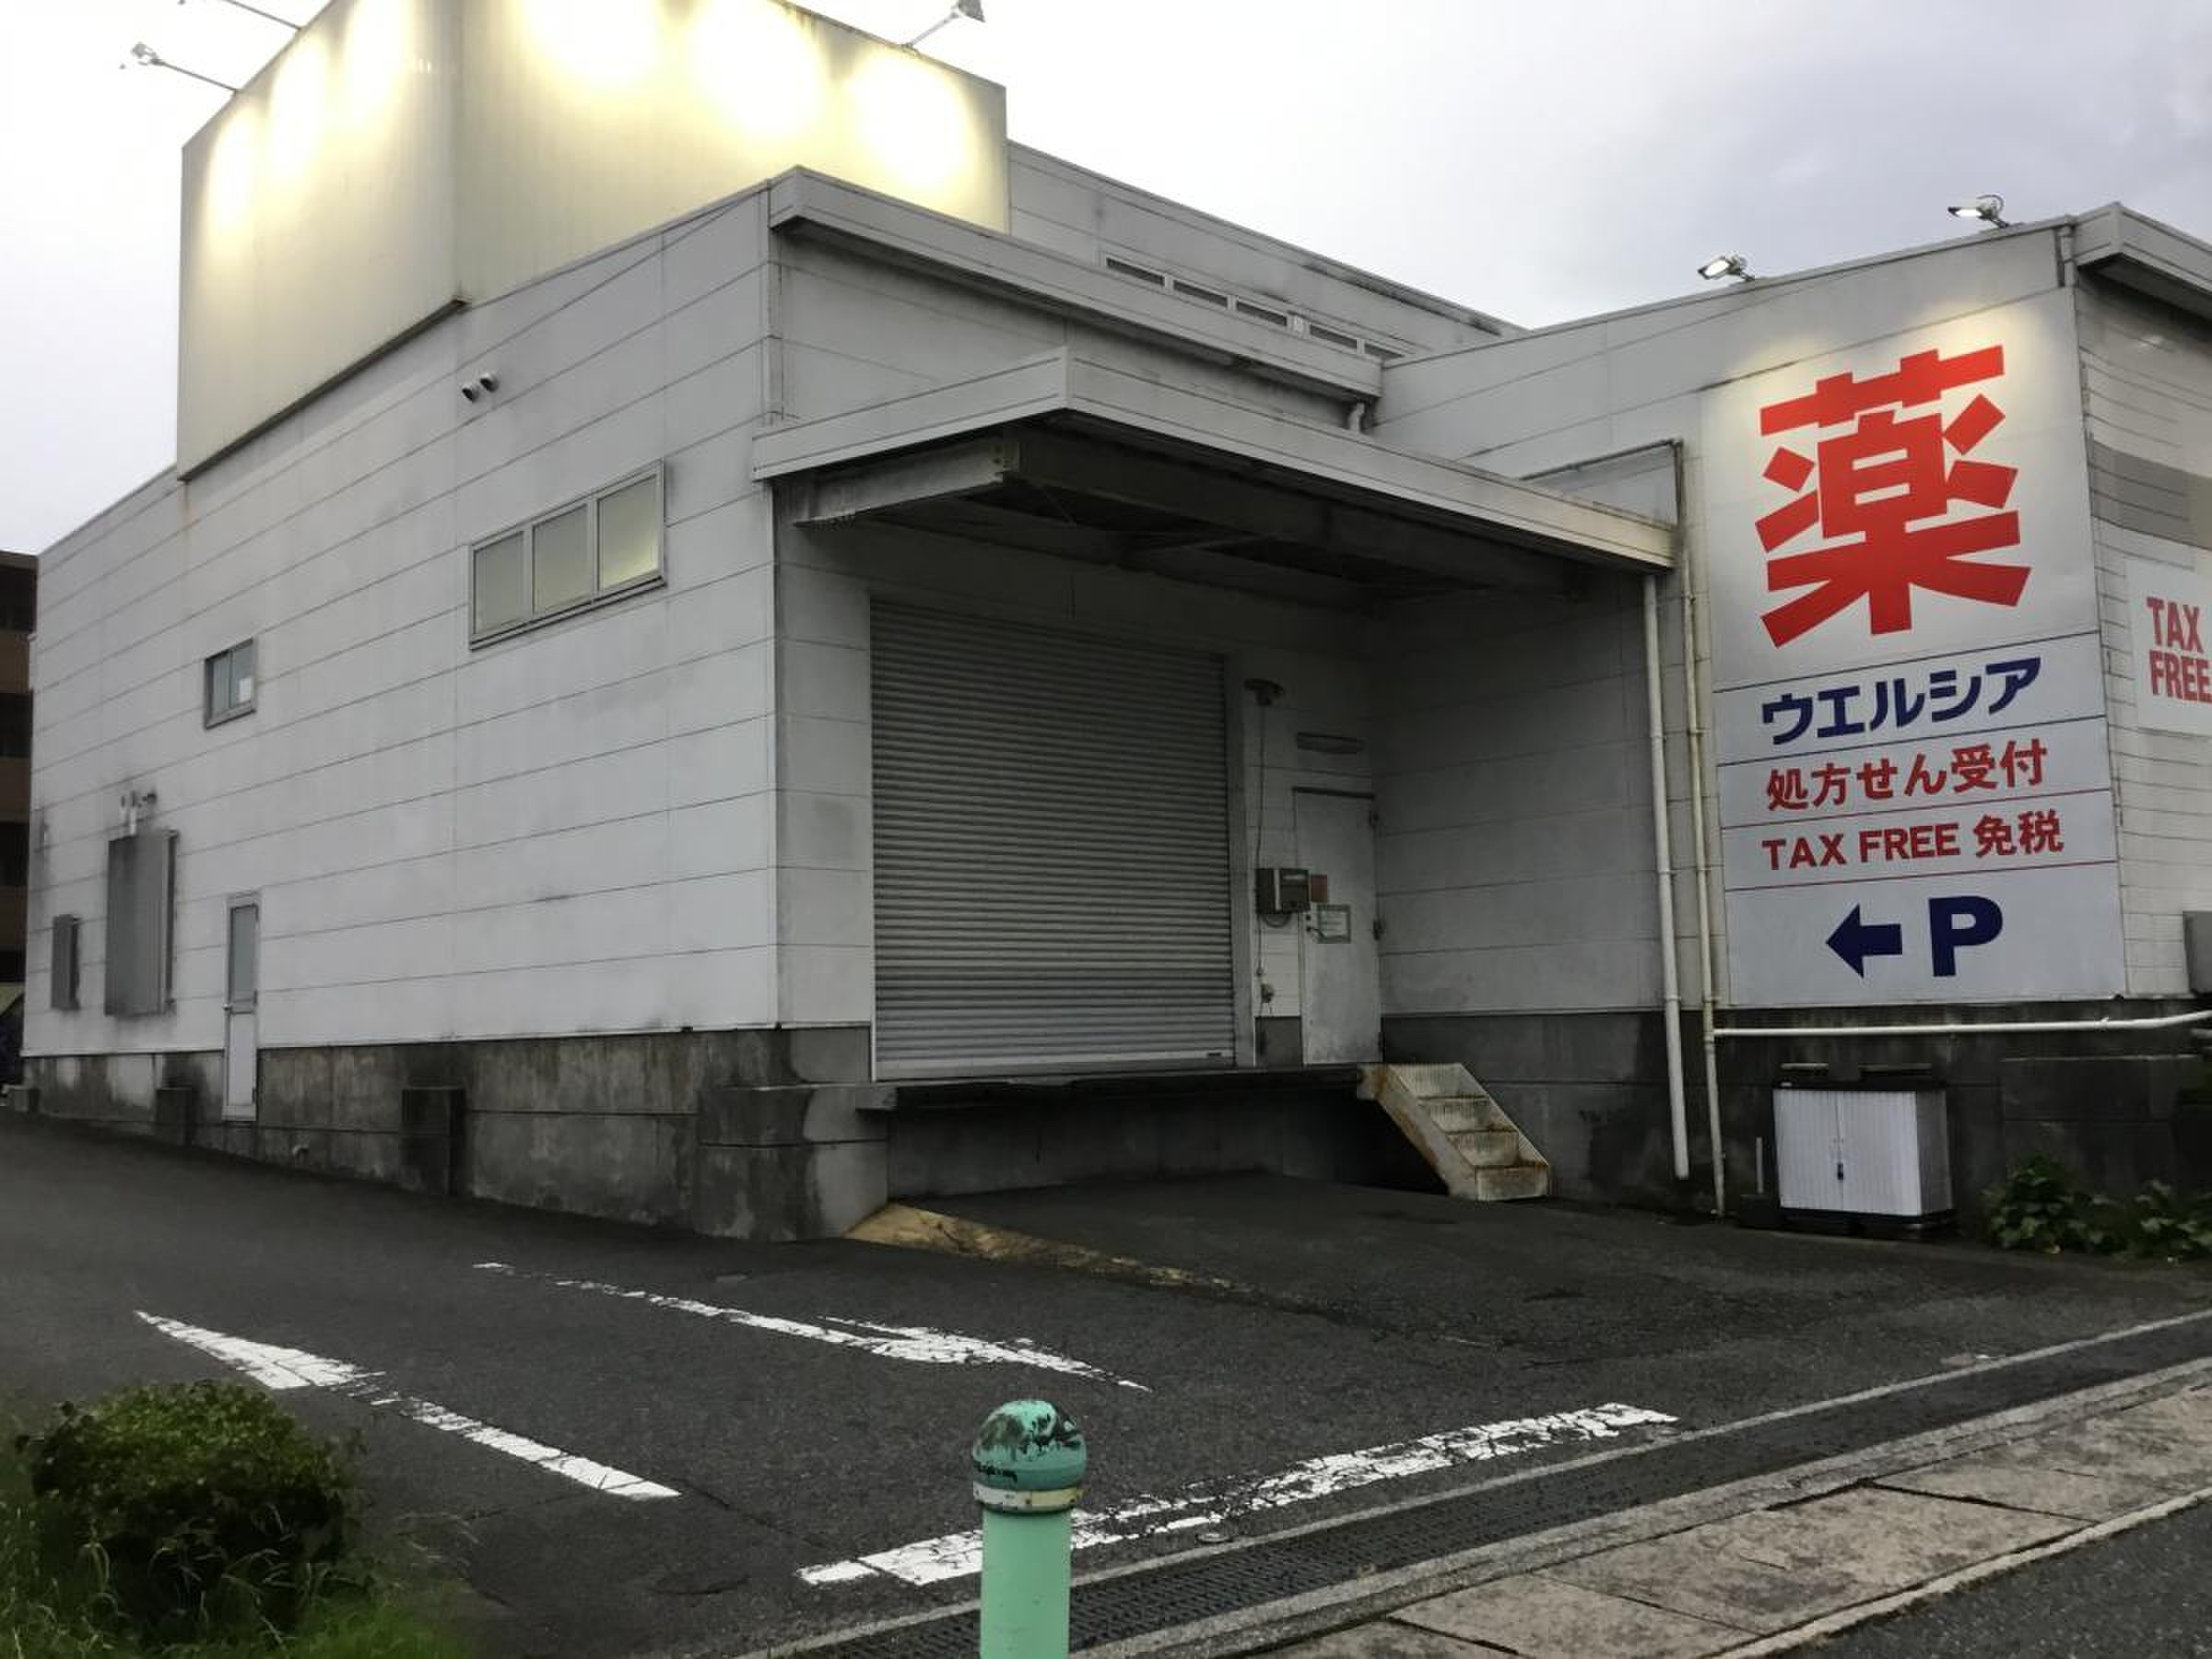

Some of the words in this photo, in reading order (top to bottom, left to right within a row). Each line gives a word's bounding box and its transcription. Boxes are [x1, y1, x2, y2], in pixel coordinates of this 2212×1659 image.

[1755, 345, 2031, 649] 薬
[2147, 596, 2203, 653] TAX
[1761, 657, 2041, 745] ウエルシア
[2149, 649, 2212, 703] FREE
[1766, 738, 2047, 811] 処方せん受付
[1762, 834, 1846, 870] TAX
[1858, 823, 1959, 863] FREE
[1972, 809, 2064, 858] 免税
[1928, 896, 2004, 977] P
